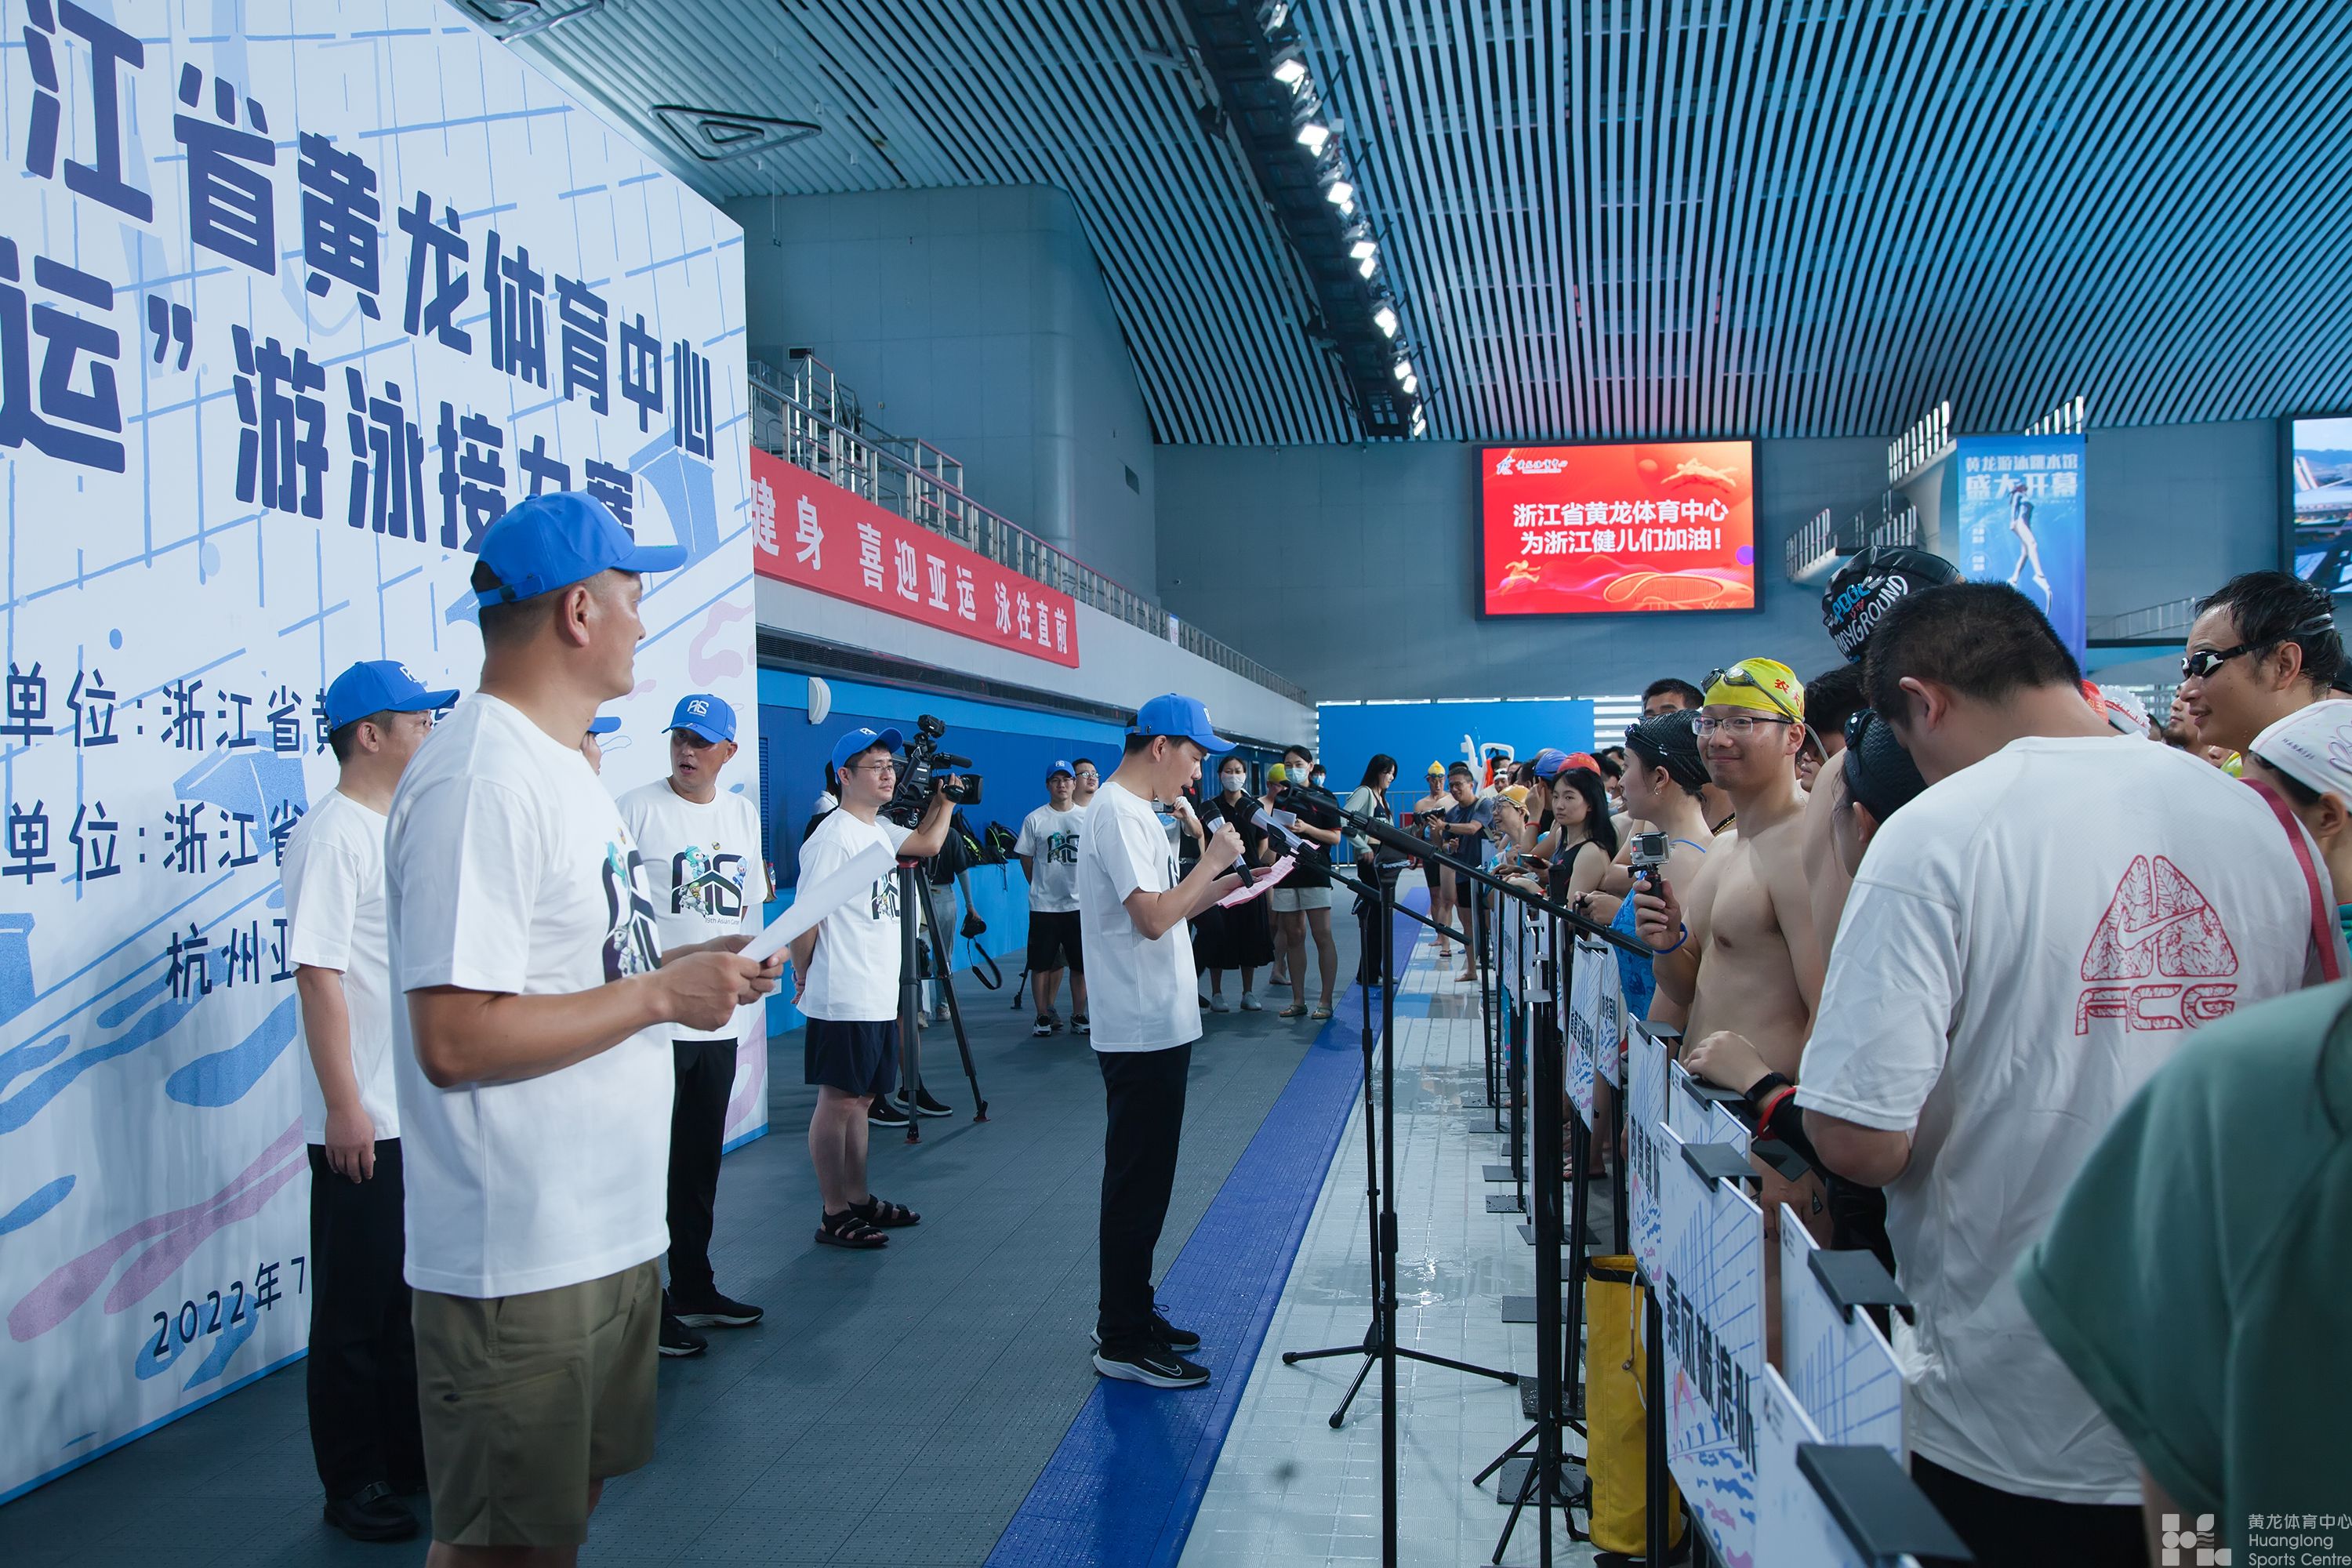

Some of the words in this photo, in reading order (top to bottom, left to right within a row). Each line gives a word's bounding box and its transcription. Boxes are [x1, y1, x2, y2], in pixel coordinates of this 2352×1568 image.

[1965, 471, 2078, 500] 盛大开幕
[1513, 498, 1730, 528] 浙江省黄龙体育中心
[1520, 526, 1722, 555] 为浙江健儿们加油！
[857, 522, 977, 622] 喜迎亚运
[993, 581, 1068, 655] 泳往直前
